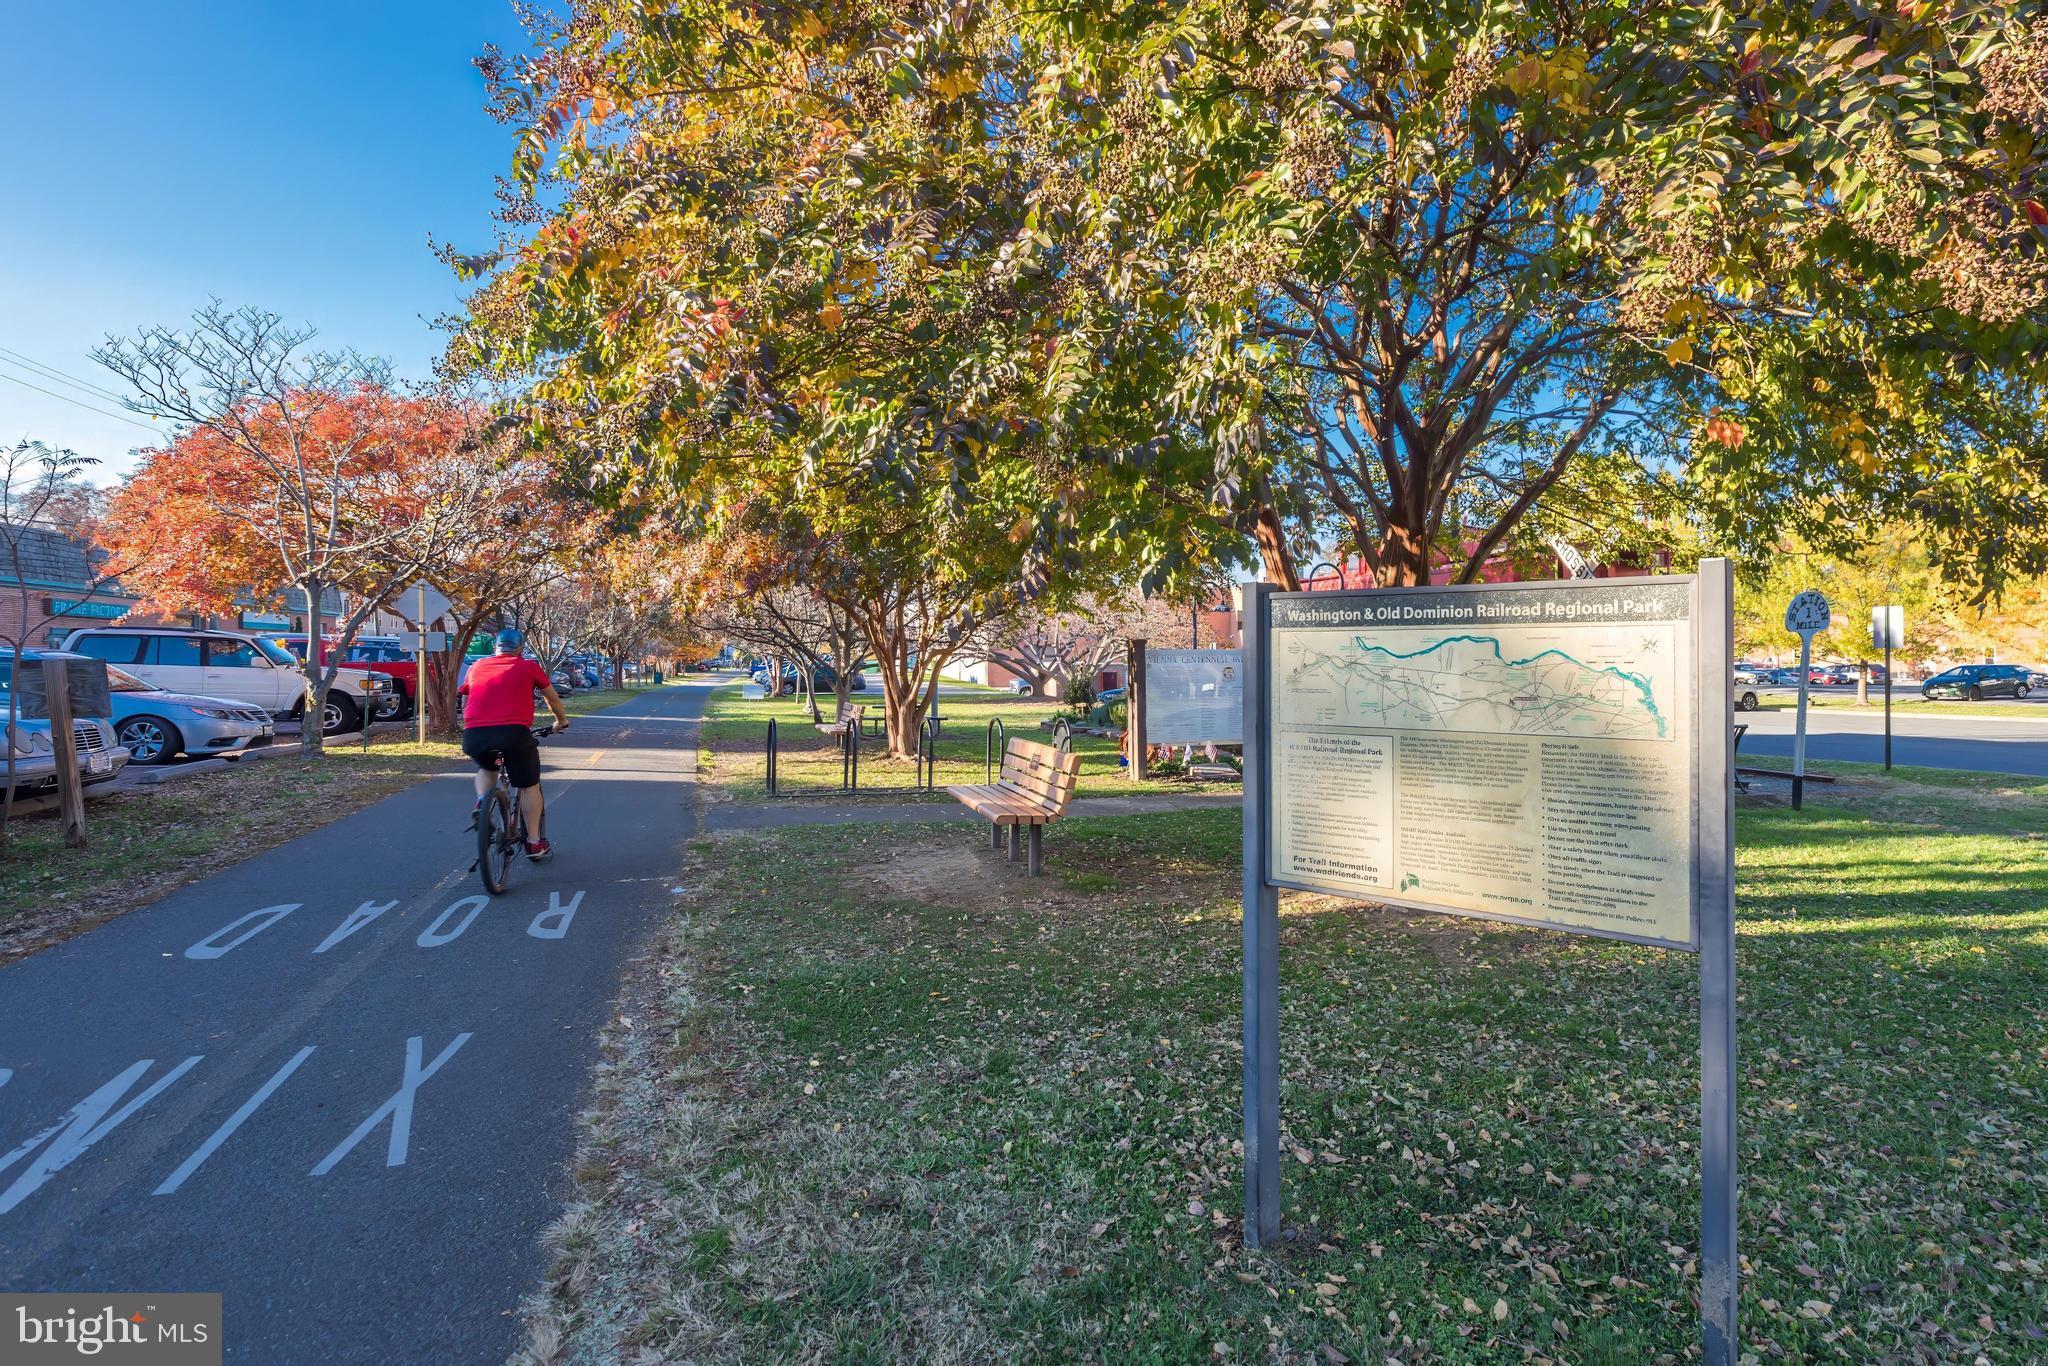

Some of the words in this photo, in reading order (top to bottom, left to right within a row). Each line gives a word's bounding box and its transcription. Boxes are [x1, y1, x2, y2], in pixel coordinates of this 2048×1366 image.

[54, 601, 88, 615] FRAME
[1287, 608, 1361, 624] Washington
[1364, 608, 1374, 620] &
[1377, 606, 1400, 620] Old
[1404, 604, 1473, 620] Dominion
[1476, 602, 1540, 618] Railroad
[1545, 600, 1620, 618] Regional
[1623, 599, 1663, 614] Park
[1788, 594, 1829, 622] STATION
[1806, 608, 1812, 618] 1
[1796, 620, 1820, 630] MILE
[1340, 746, 1366, 755] Regional
[1308, 857, 1326, 866] Trail
[1329, 860, 1378, 872] Information
[1293, 865, 1378, 883] www.wodfriends.org
[184, 890, 586, 959] ROAD
[0, 1032, 473, 1214] XIN
